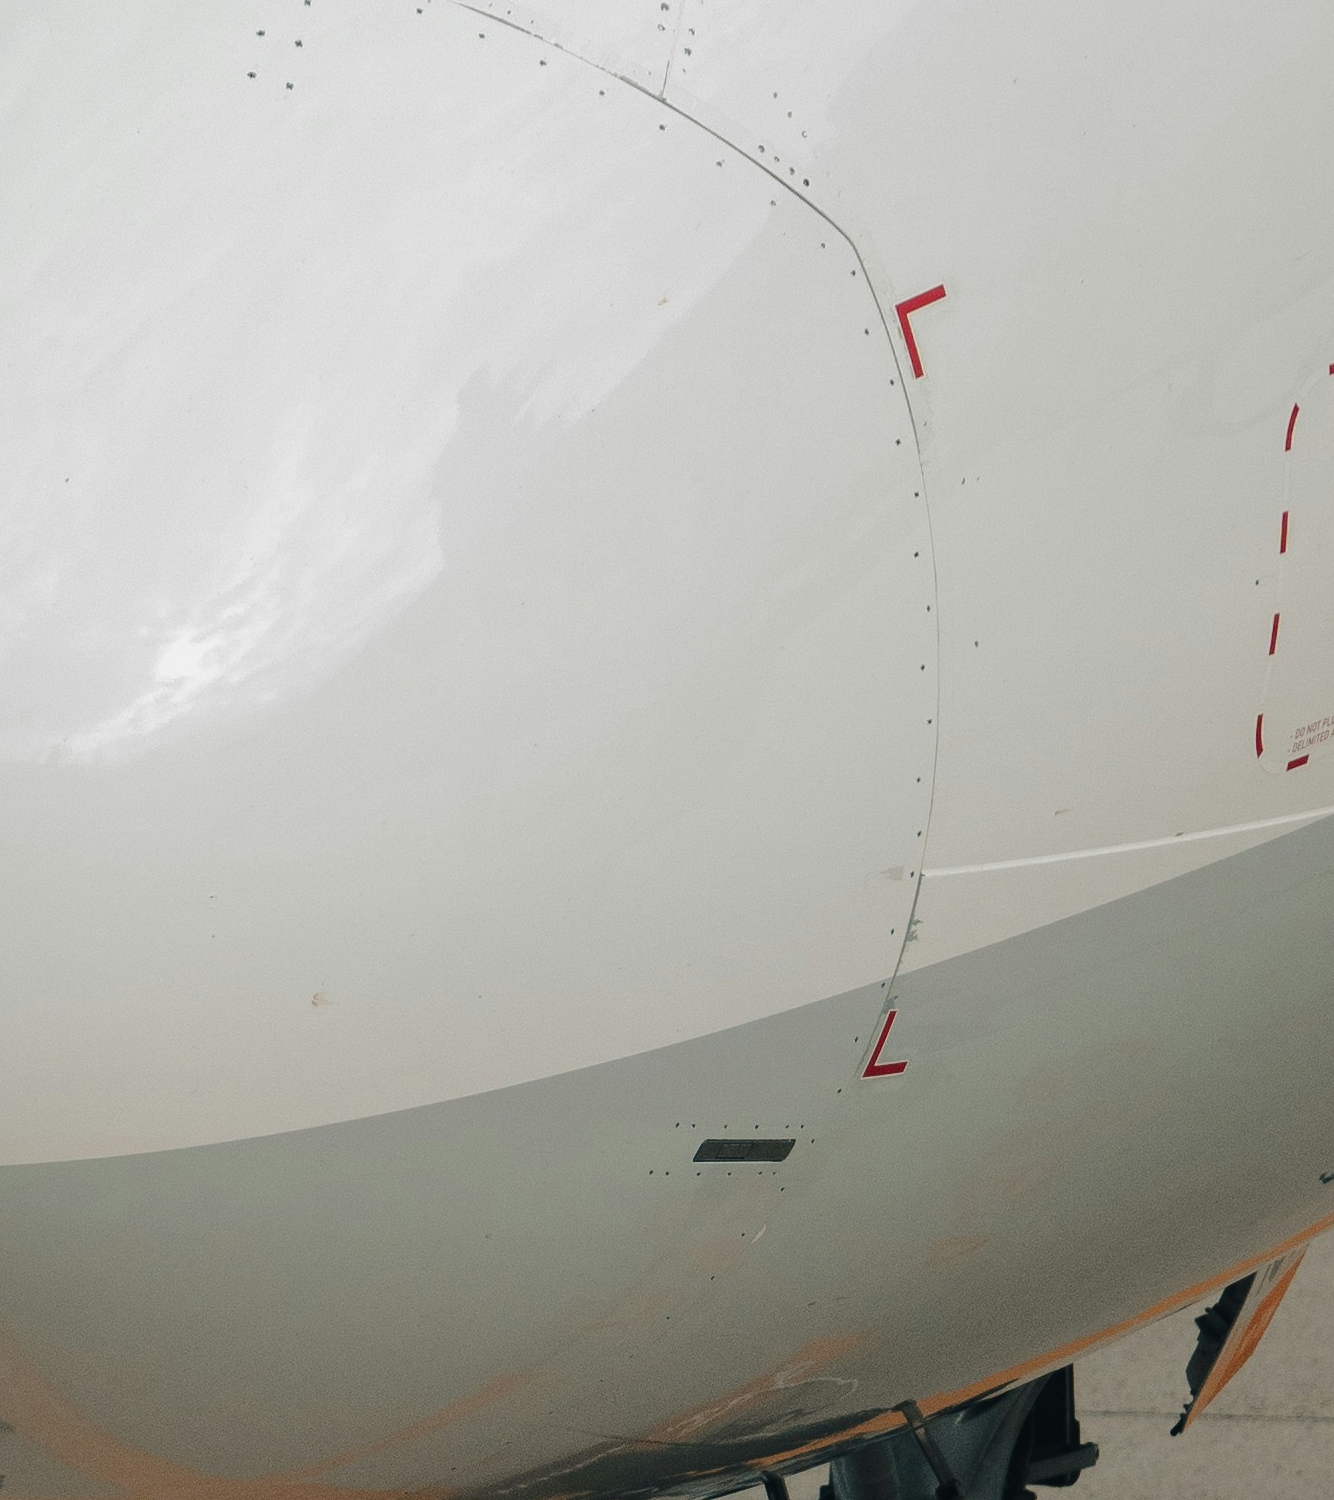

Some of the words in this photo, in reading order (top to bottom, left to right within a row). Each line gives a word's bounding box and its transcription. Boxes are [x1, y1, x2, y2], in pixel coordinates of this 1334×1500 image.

[1295, 726, 1305, 739] DO
[1307, 720, 1321, 733] NOT
[1292, 730, 1329, 752] DELIMITED
